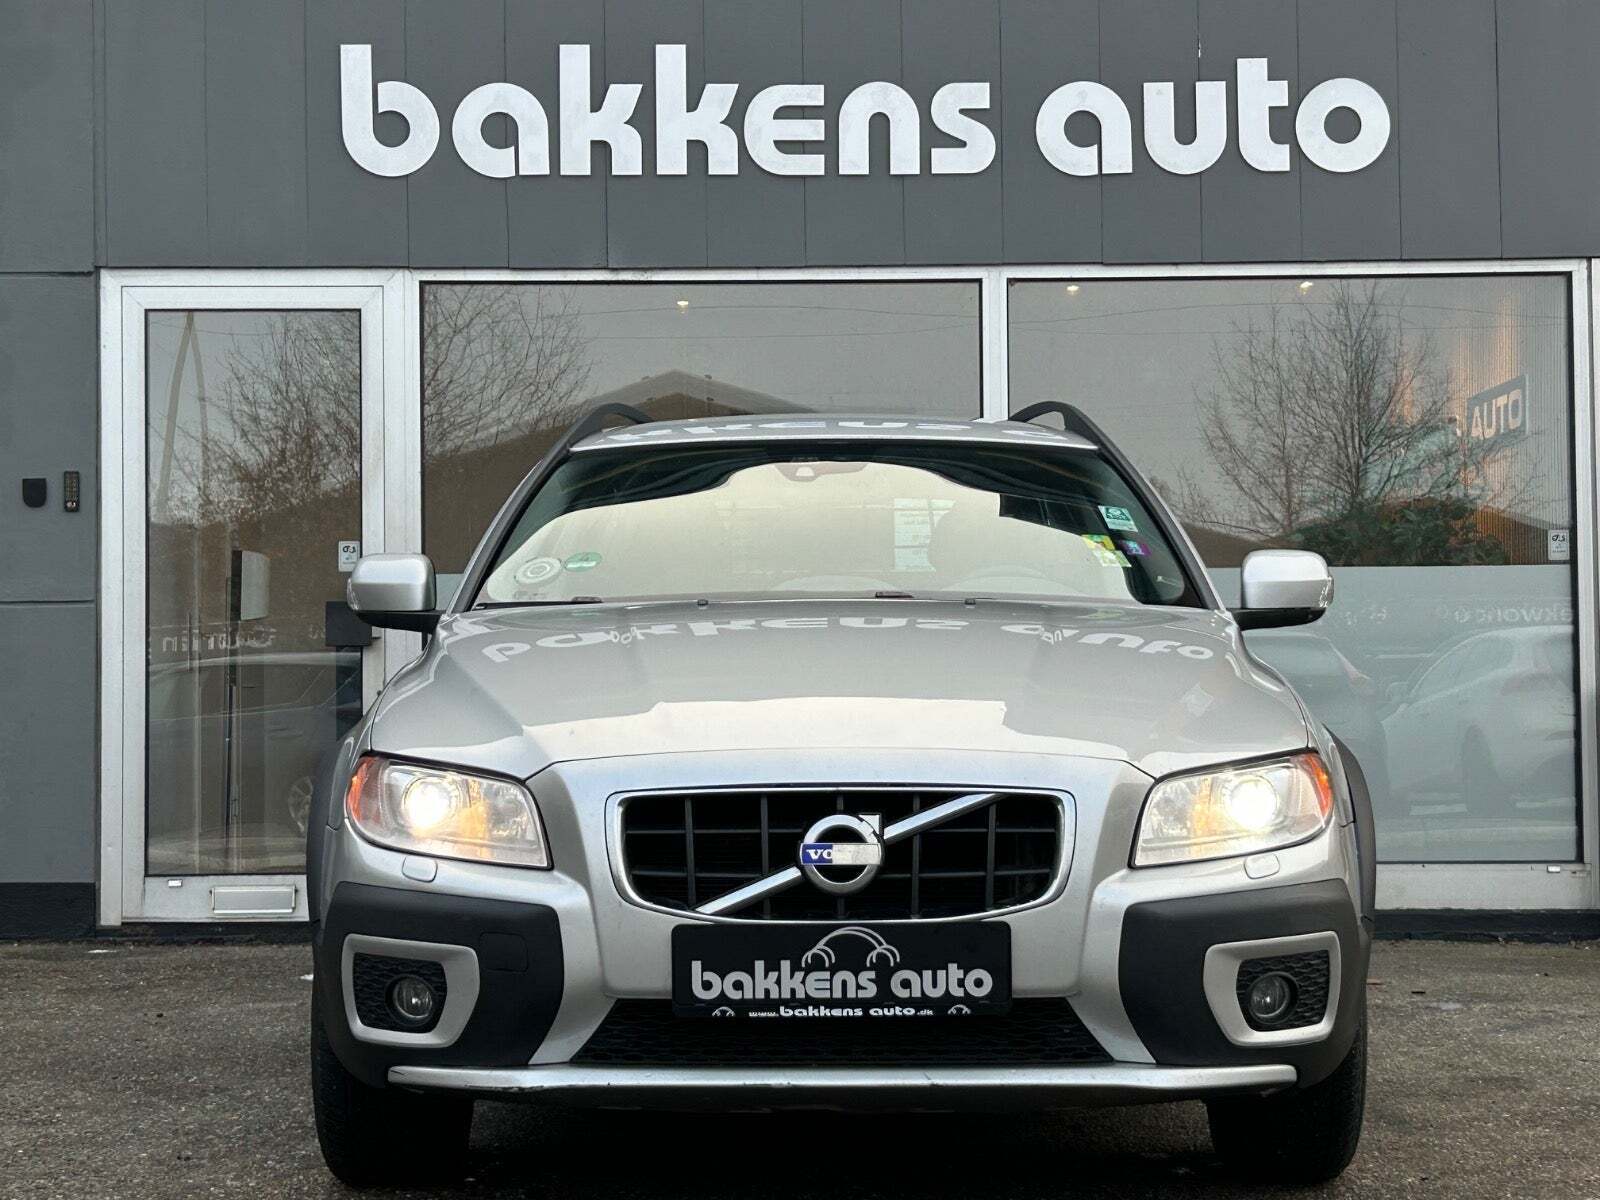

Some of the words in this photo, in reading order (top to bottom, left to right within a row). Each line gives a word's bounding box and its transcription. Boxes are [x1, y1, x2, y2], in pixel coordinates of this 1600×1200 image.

[340, 44, 996, 178] bakkens
[1036, 57, 1391, 176] auto
[1471, 389, 1522, 439] AUTO
[691, 960, 877, 1000] bakkens
[891, 963, 993, 998] auto
